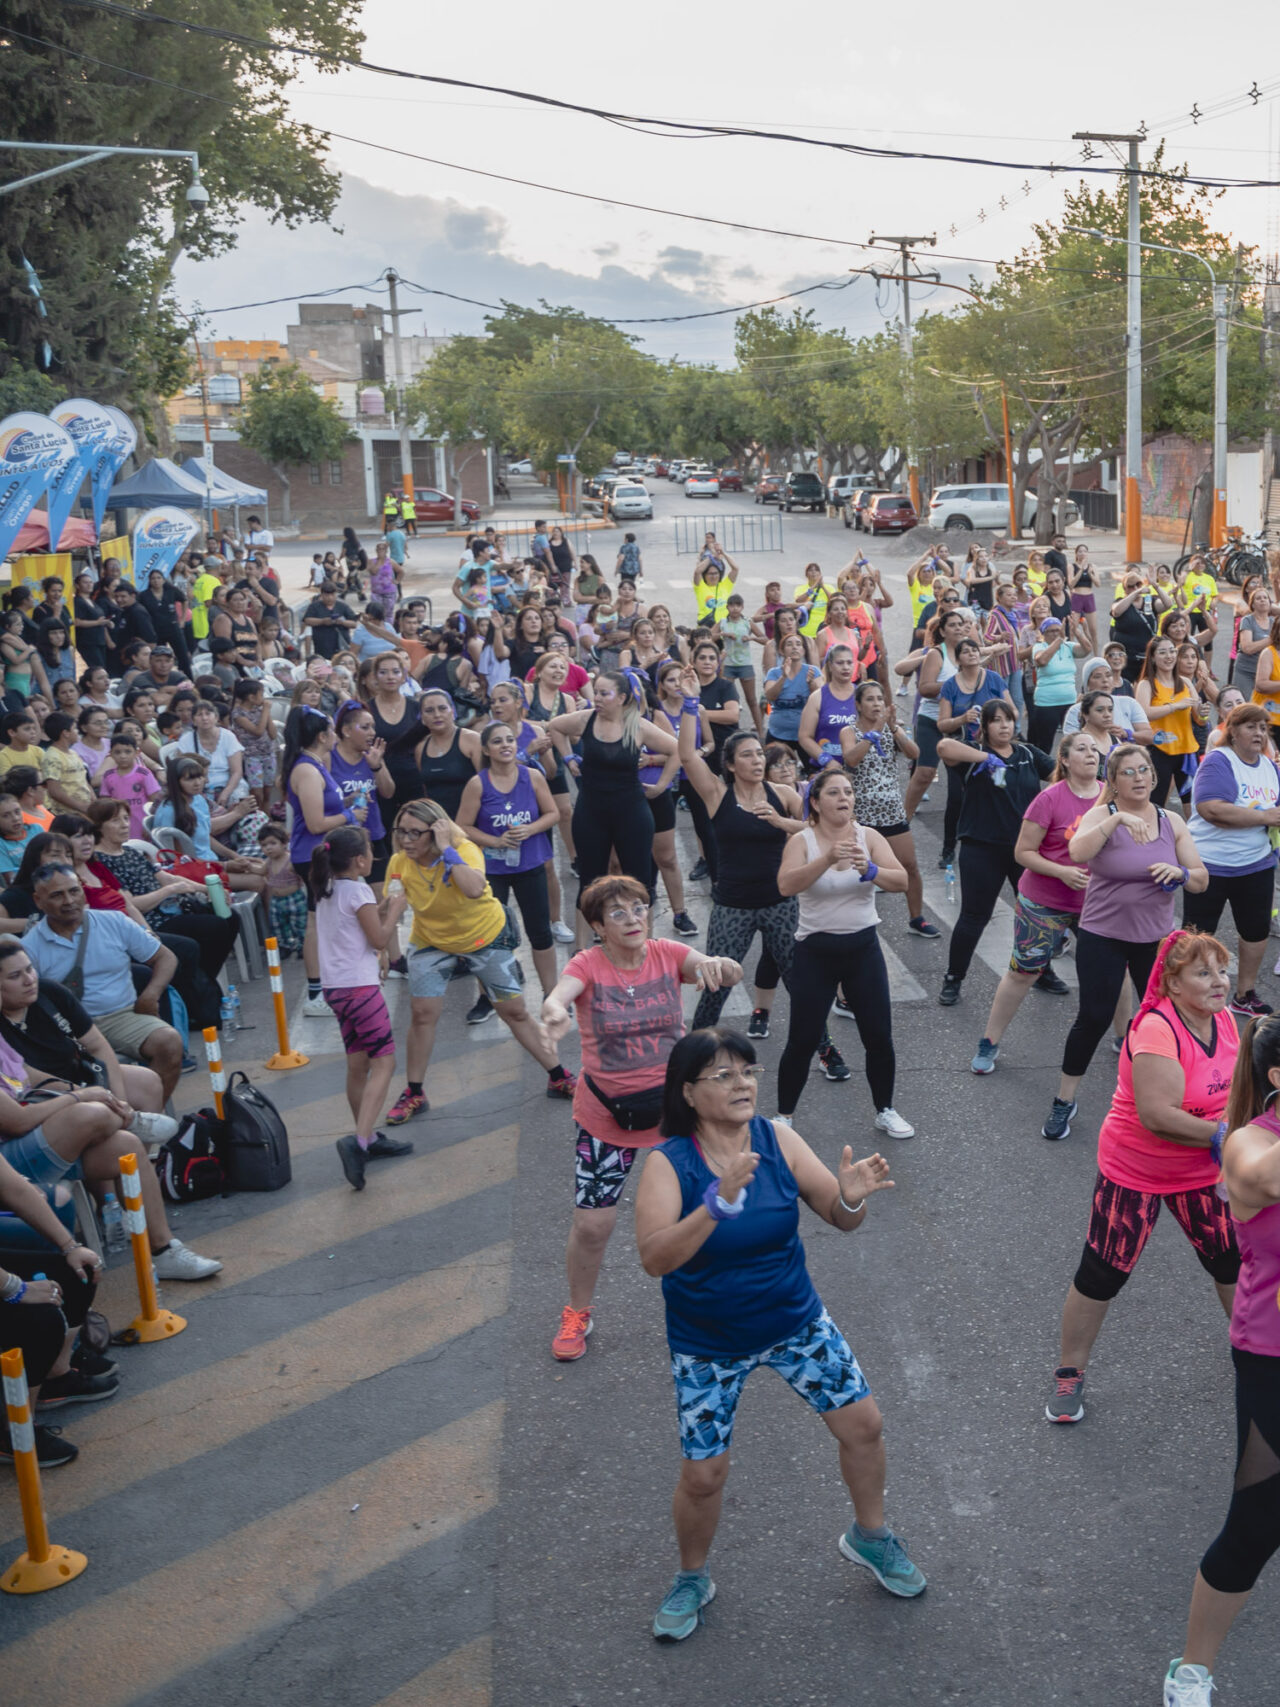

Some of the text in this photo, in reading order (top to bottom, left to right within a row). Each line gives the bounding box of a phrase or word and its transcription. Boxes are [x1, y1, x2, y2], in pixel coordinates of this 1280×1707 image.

[12, 443, 41, 454] Santa
[490, 811, 532, 828] ZUMBA
[625, 1036, 661, 1059] NY
